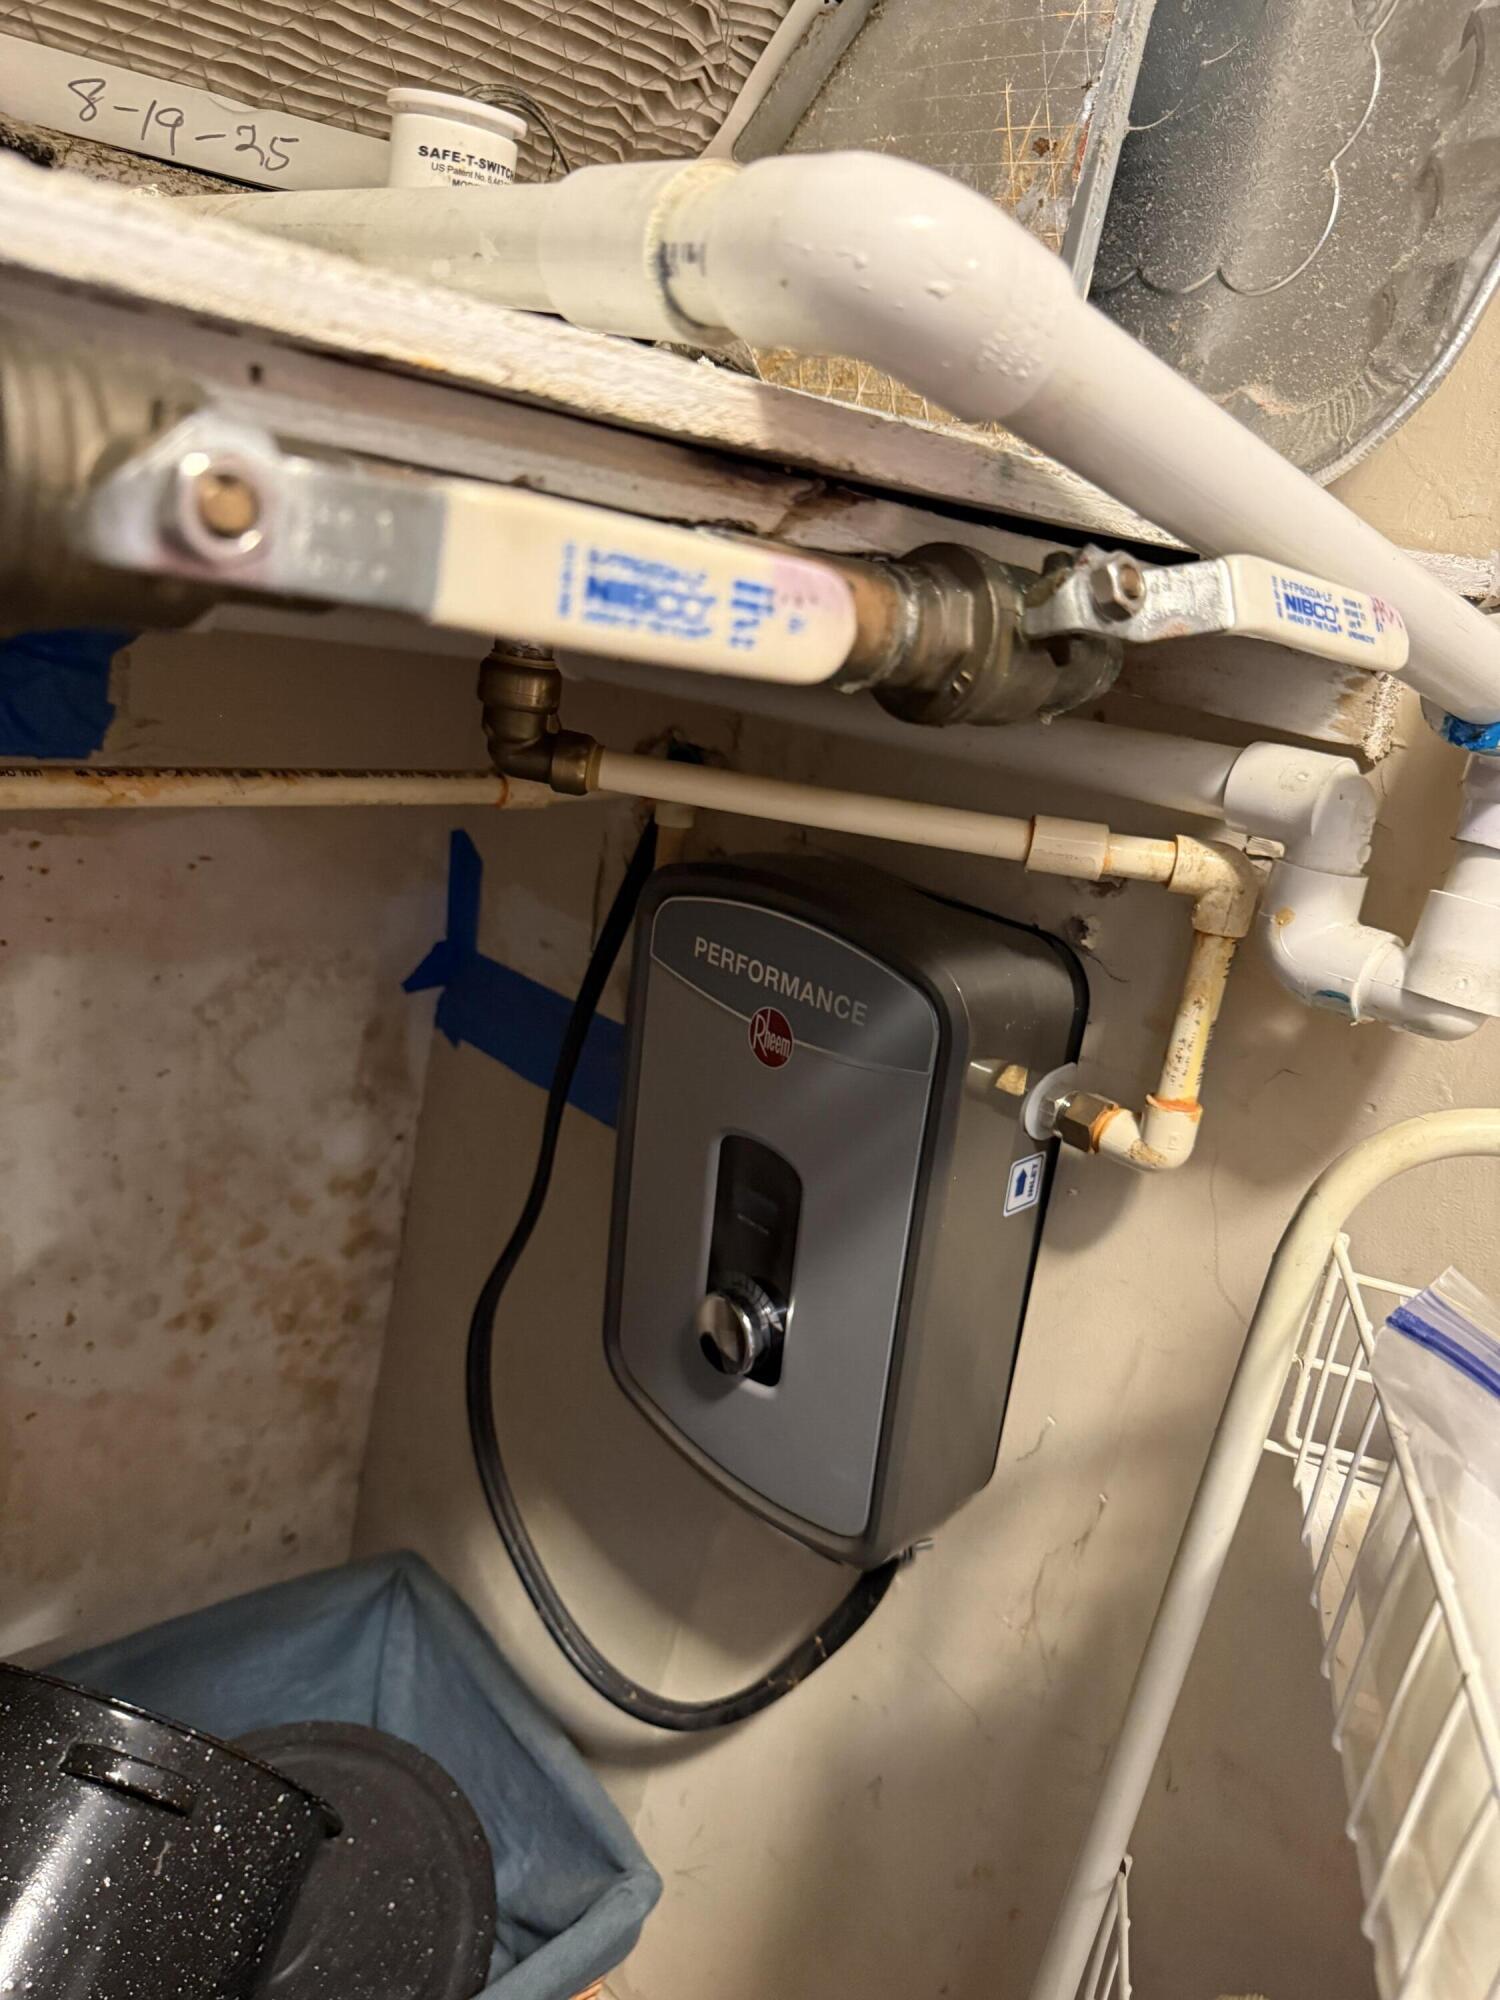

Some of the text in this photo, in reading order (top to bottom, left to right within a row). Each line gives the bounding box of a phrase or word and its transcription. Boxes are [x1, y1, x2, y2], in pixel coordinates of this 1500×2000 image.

[68, 78, 299, 171] 8-19-25
[431, 162, 445, 173] US
[447, 165, 473, 179] Patent
[694, 936, 868, 1027] PERFORMANCE
[752, 1009, 791, 1058] Rheem
